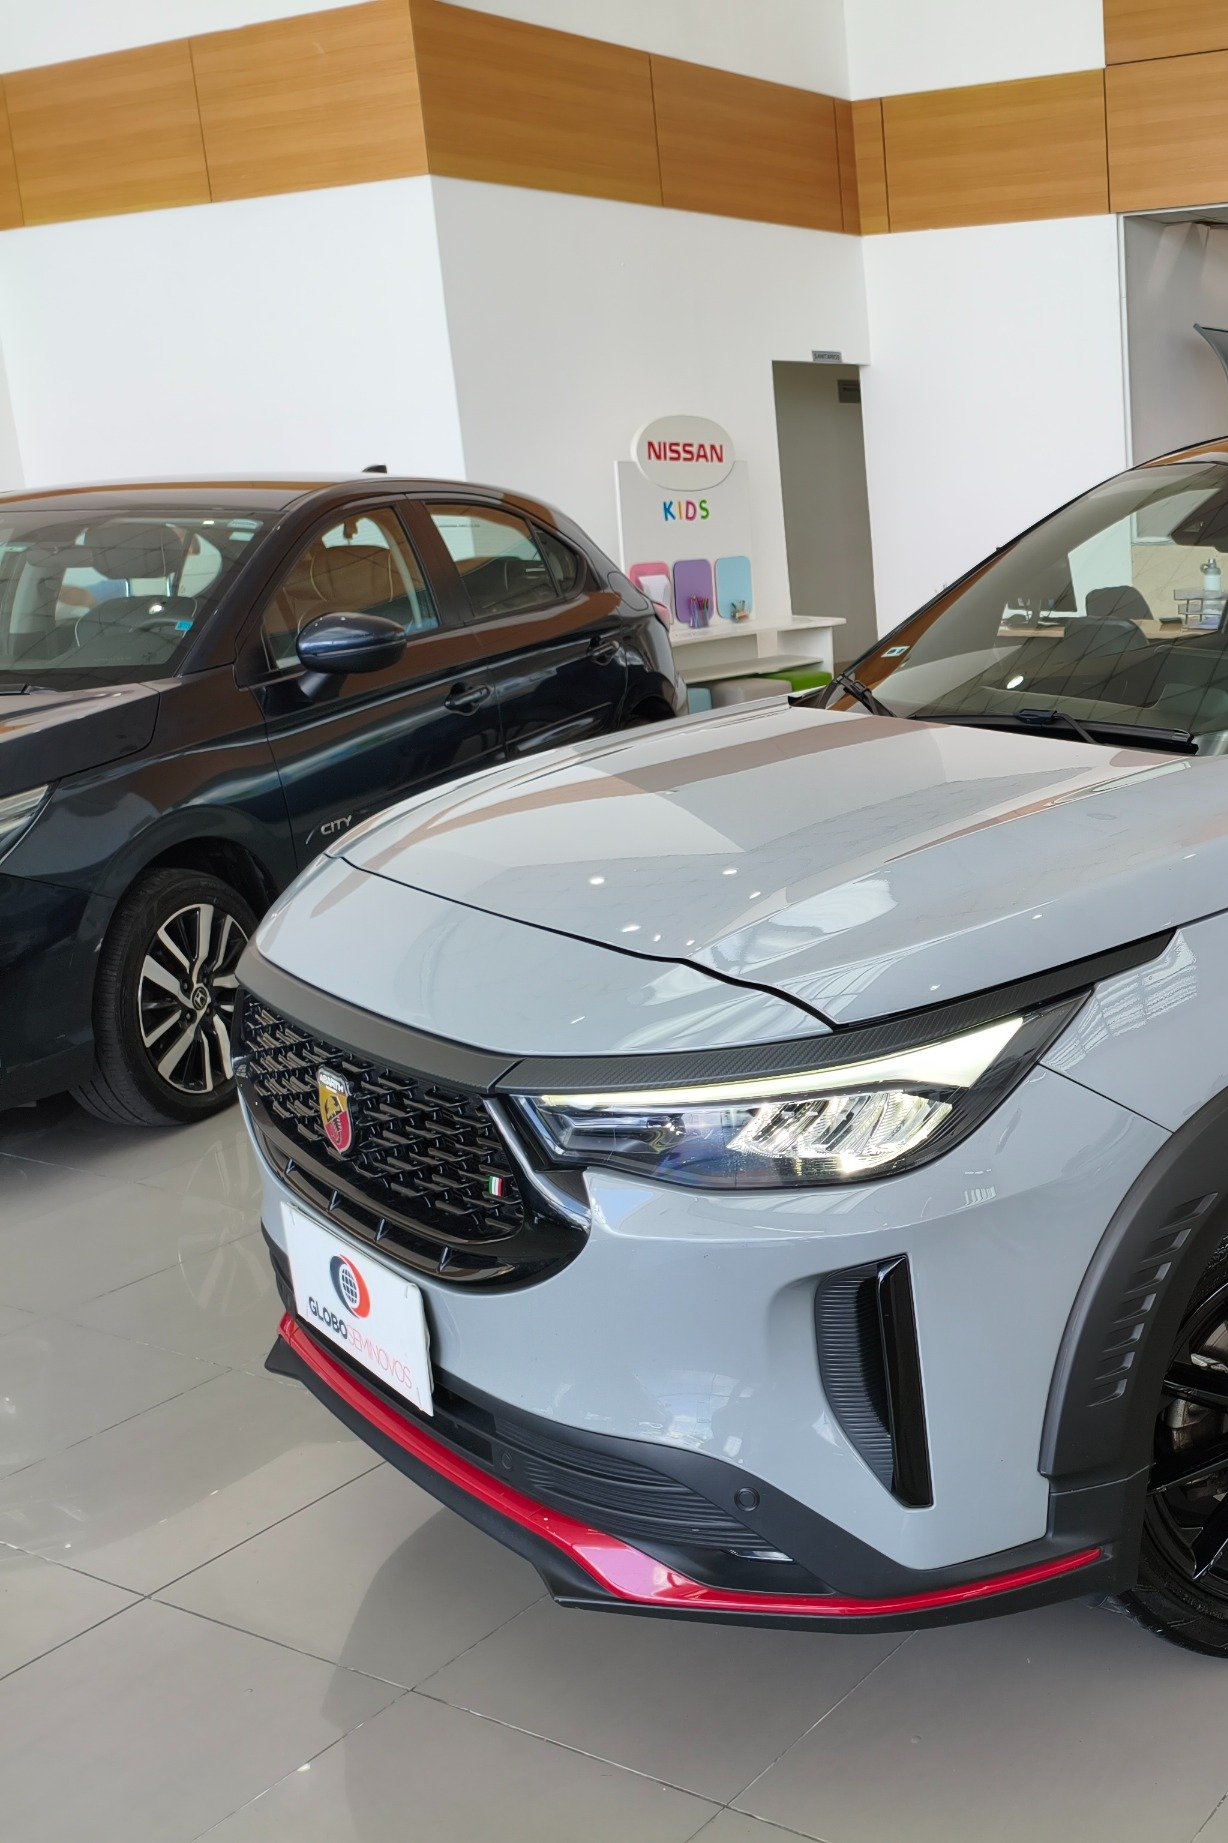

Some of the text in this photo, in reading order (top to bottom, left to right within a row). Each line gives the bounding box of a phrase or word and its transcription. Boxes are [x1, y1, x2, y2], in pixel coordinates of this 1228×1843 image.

[647, 441, 725, 463] NISSAN
[663, 500, 710, 521] KIDS
[320, 815, 352, 835] CITY
